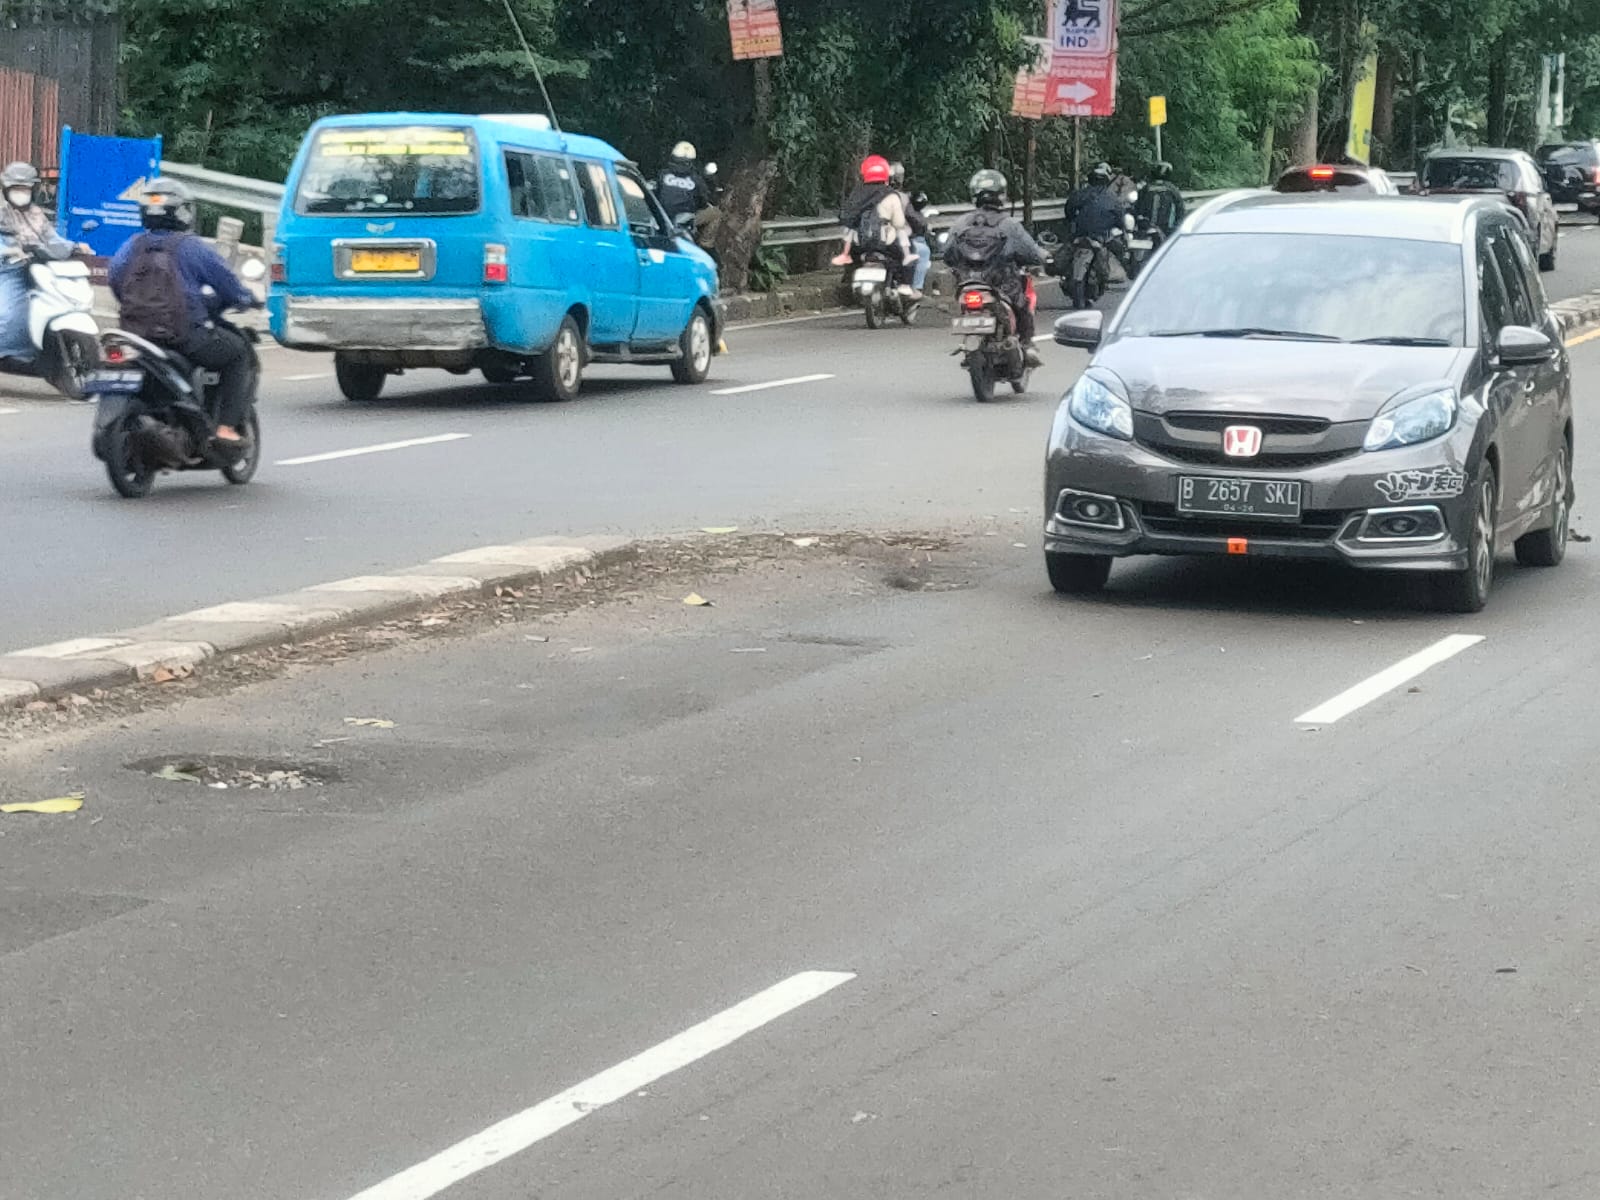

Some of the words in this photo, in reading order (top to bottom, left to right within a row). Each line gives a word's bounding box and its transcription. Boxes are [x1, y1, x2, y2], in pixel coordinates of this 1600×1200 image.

[1182, 478, 1195, 500] B
[1207, 480, 1252, 503] 2657
[1264, 483, 1298, 505] SKL
